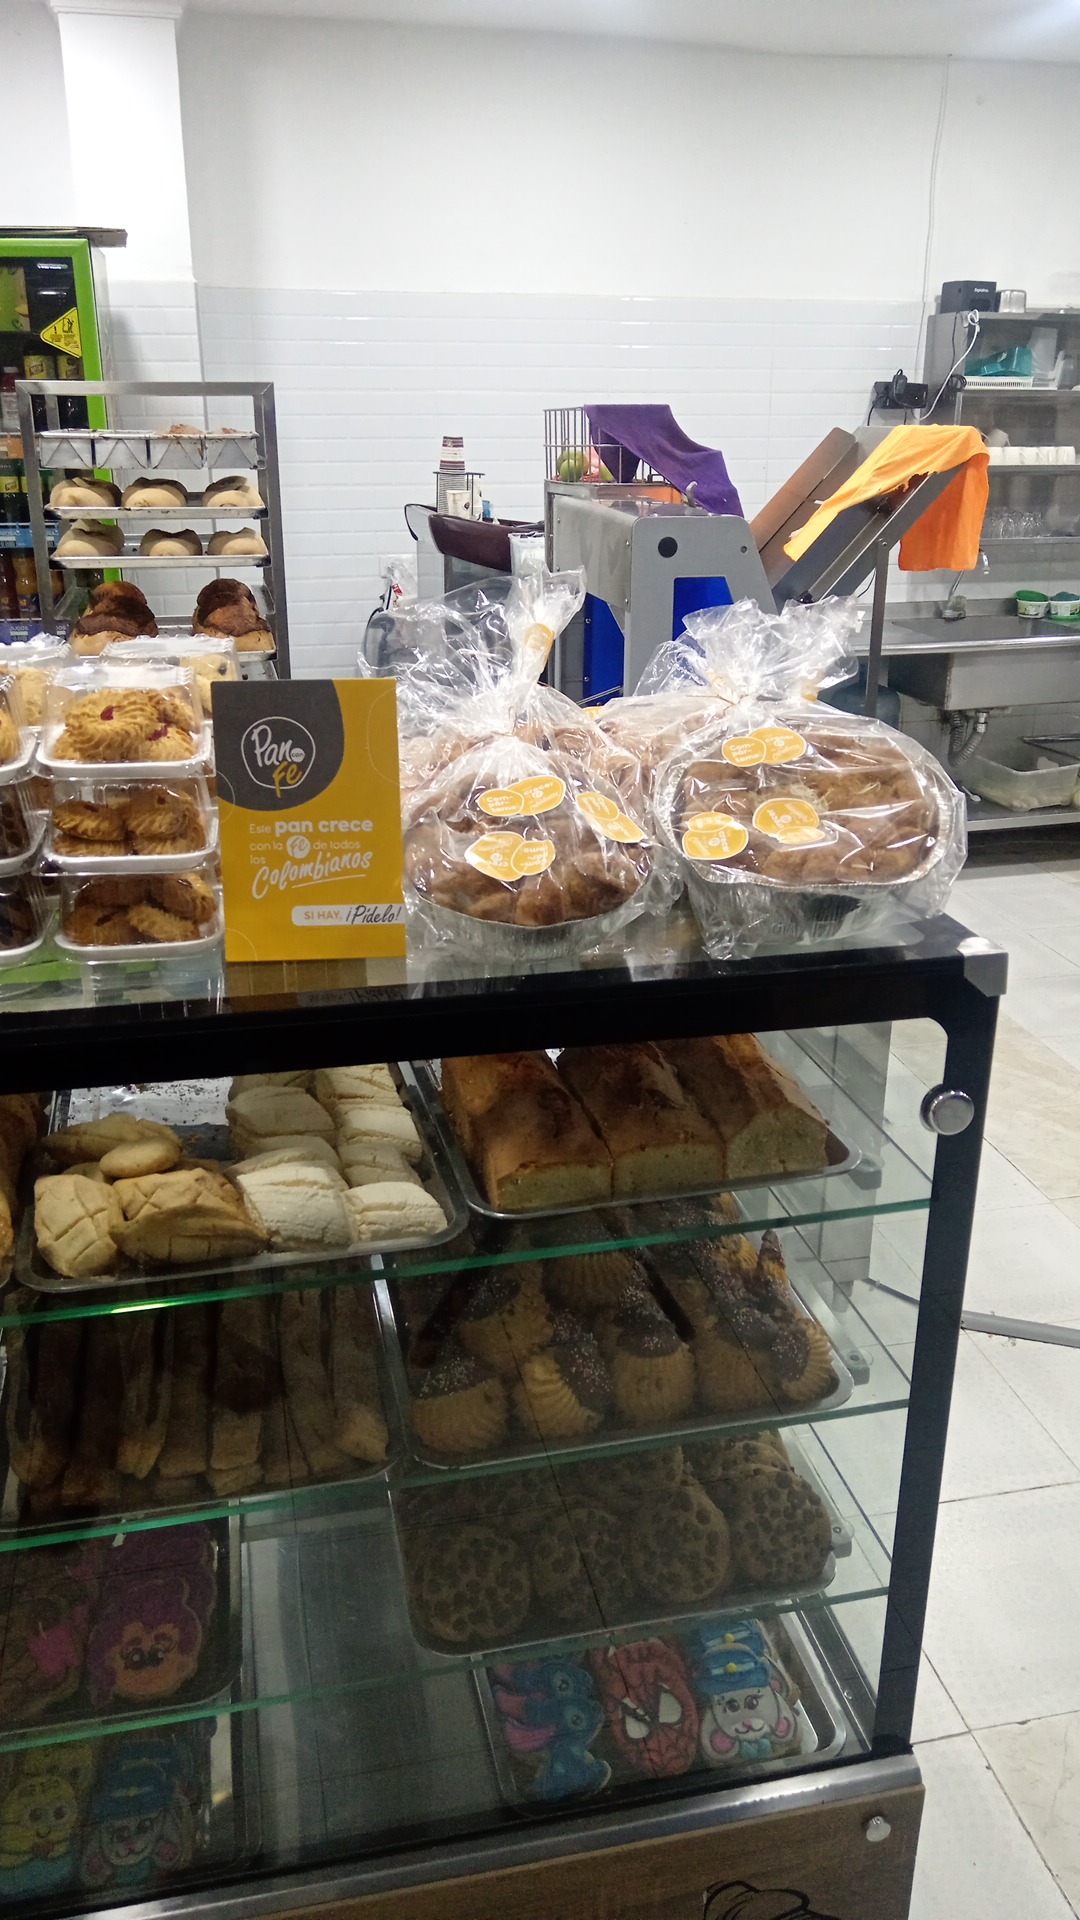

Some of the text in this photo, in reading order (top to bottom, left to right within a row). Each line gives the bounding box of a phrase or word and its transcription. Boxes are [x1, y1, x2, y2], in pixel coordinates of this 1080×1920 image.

[251, 724, 293, 768] Pan
[249, 819, 374, 838] Este pan crece
[249, 843, 271, 851] con
[313, 841, 328, 850] de
[330, 840, 361, 850] todos
[250, 855, 267, 865] los
[252, 850, 374, 900] Colombianos
[304, 911, 315, 921] SI
